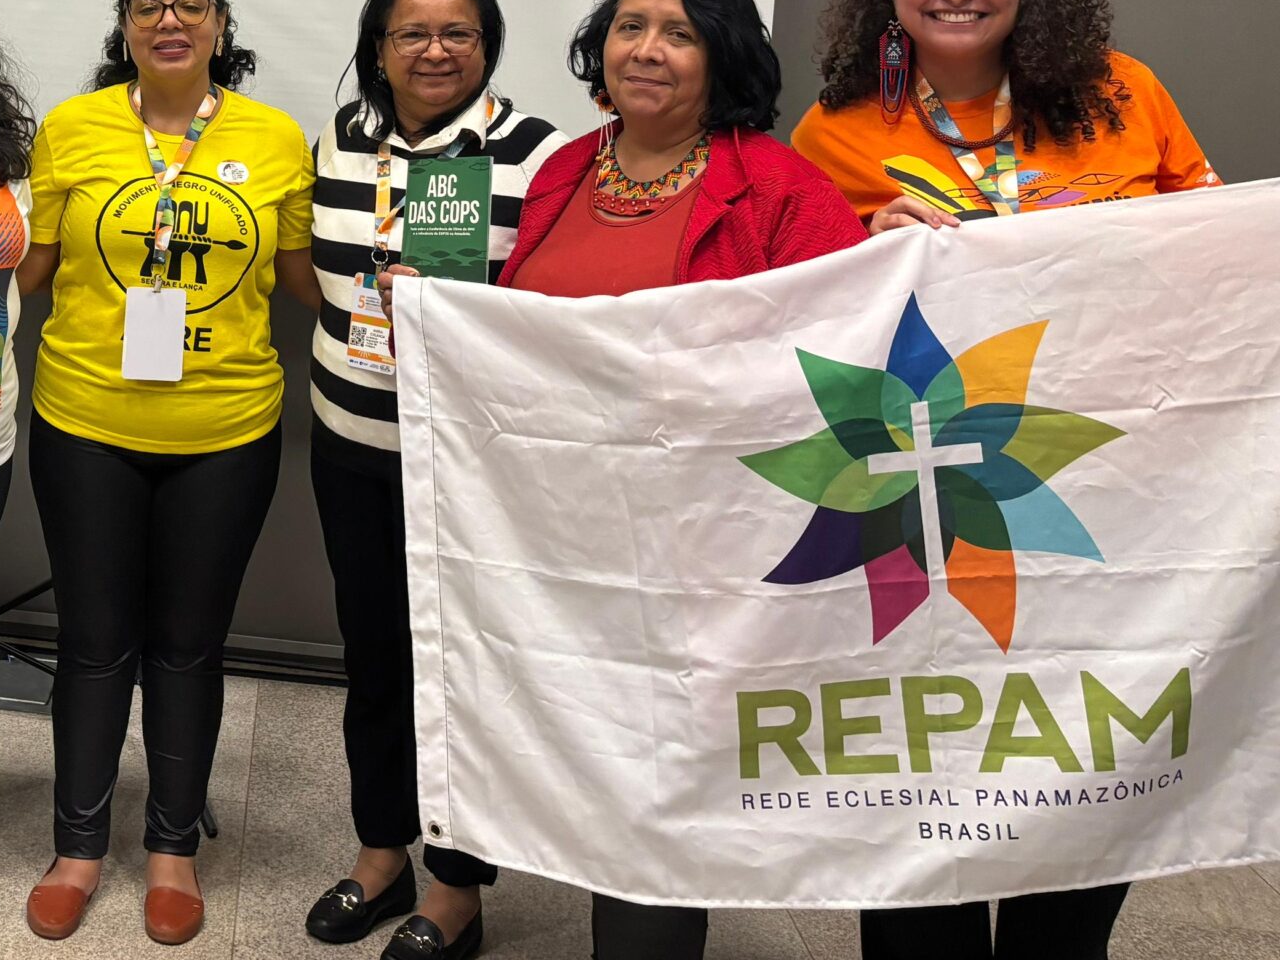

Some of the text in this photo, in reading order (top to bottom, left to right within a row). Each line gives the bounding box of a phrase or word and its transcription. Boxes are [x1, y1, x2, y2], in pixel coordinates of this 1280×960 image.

[427, 174, 457, 198] ABC
[113, 183, 158, 218] MOVIMENT
[210, 189, 248, 235] UNIFICADO
[408, 200, 480, 224] DAS COPS
[179, 282, 203, 291] LANÇA
[735, 666, 1193, 780] REPAM
[741, 769, 1184, 811] REDE ECLESIAL PANAMAZÔNICA
[918, 821, 1020, 841] BRASIL
